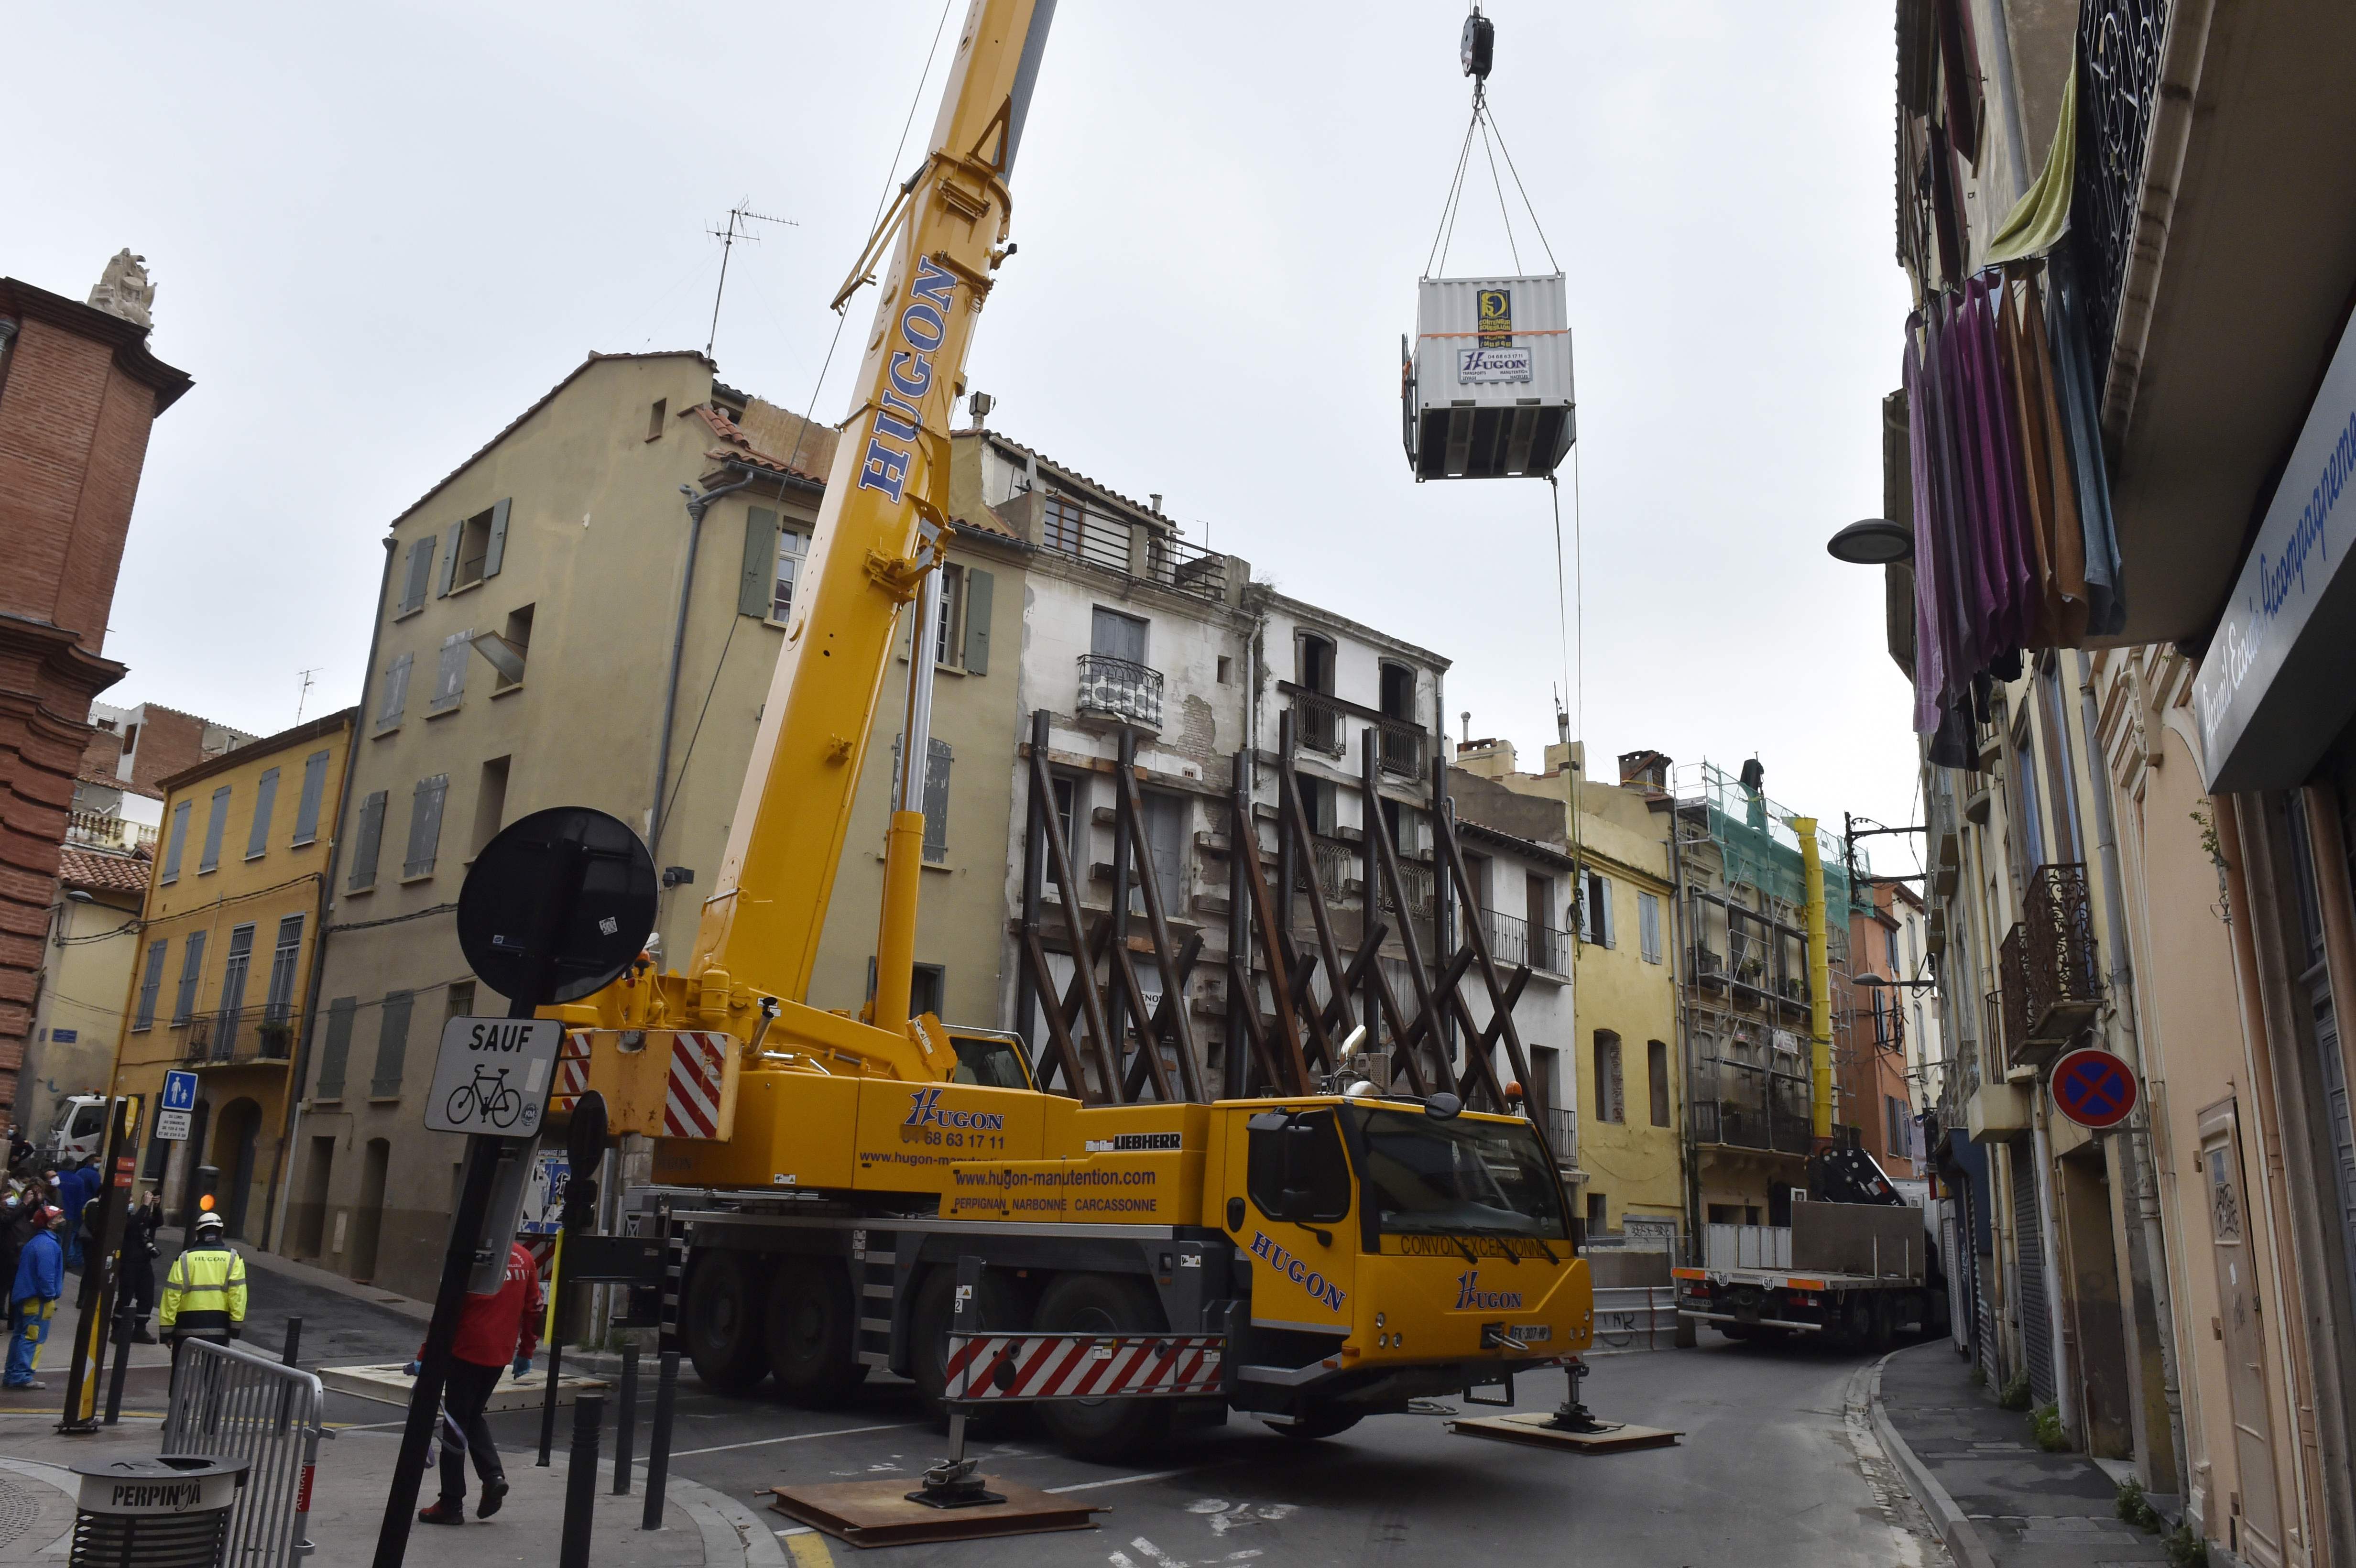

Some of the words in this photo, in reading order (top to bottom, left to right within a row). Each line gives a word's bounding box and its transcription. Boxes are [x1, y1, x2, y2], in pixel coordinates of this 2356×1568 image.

[1462, 352, 1527, 370] HUGON
[857, 253, 958, 504] HUGON
[2203, 645, 2232, 748] Accueil
[469, 1024, 533, 1053] SAUF
[905, 1087, 1004, 1130] HUGON
[925, 1132, 941, 1145] 68
[946, 1133, 963, 1147] 63
[968, 1134, 985, 1148] 17
[989, 1136, 1004, 1150] 11
[1114, 1133, 1181, 1150] LIEBHERR
[955, 1168, 1156, 1188] www.hugon-manutention.com
[954, 1198, 1006, 1210] PERPIGNAN
[1012, 1198, 1067, 1211] NARBONNE
[1074, 1198, 1156, 1211] CARCASSONNE
[1401, 1236, 1454, 1255] CONVOI
[1249, 1229, 1347, 1313] HUGON
[1454, 1270, 1522, 1310] HUGON
[1718, 1274, 1727, 1285] 80
[1764, 1278, 1773, 1289] 90
[955, 1300, 960, 1311] 2
